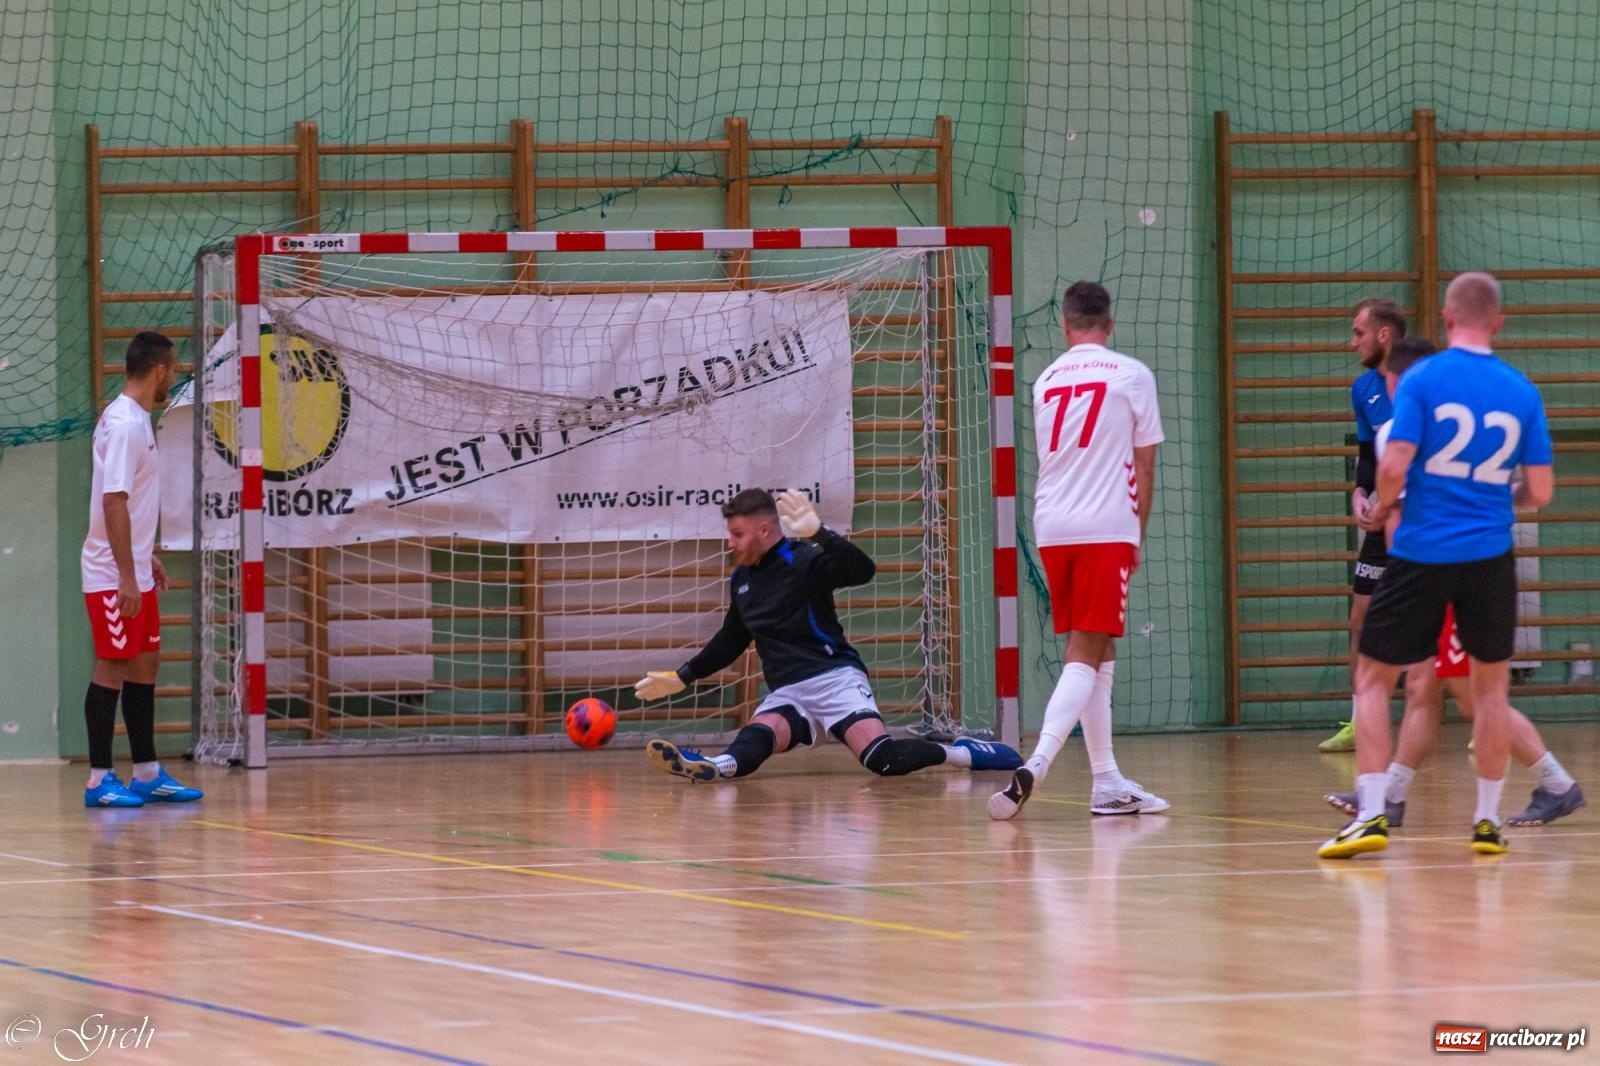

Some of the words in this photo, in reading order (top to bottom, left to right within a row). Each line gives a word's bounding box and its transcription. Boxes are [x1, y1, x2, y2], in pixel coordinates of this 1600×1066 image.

[313, 239, 344, 250] sport
[1043, 382, 1108, 453] 77
[1424, 403, 1522, 485] 22
[385, 435, 486, 501] JEST
[498, 418, 543, 462] W
[203, 482, 355, 520] RAIBÓRZ
